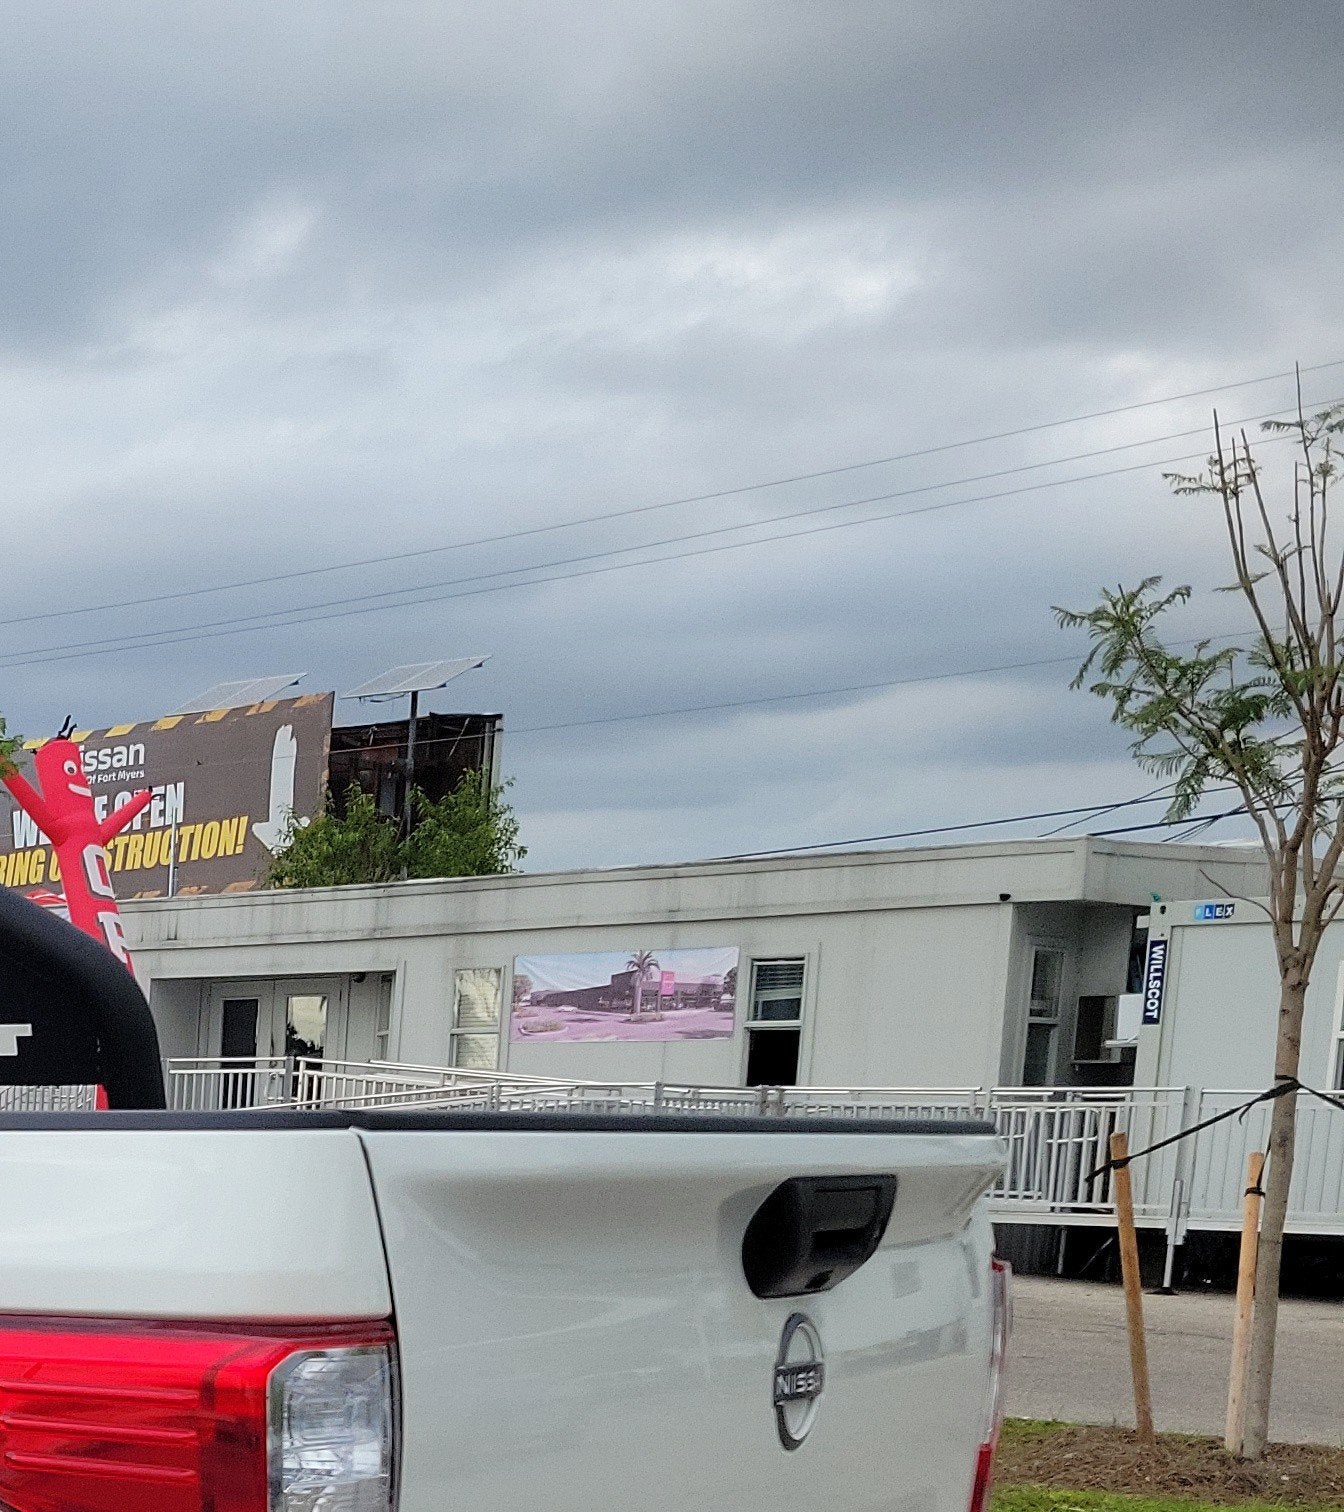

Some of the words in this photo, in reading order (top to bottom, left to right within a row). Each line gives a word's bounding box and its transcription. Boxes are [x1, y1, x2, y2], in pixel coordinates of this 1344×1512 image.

[78, 743, 146, 774] issan
[97, 772, 116, 784] Fort
[117, 769, 145, 782] Myers
[49, 815, 249, 882] CSTRUCTION!
[1194, 904, 1235, 919] FLEX
[1144, 943, 1166, 1020] WILLSCOT
